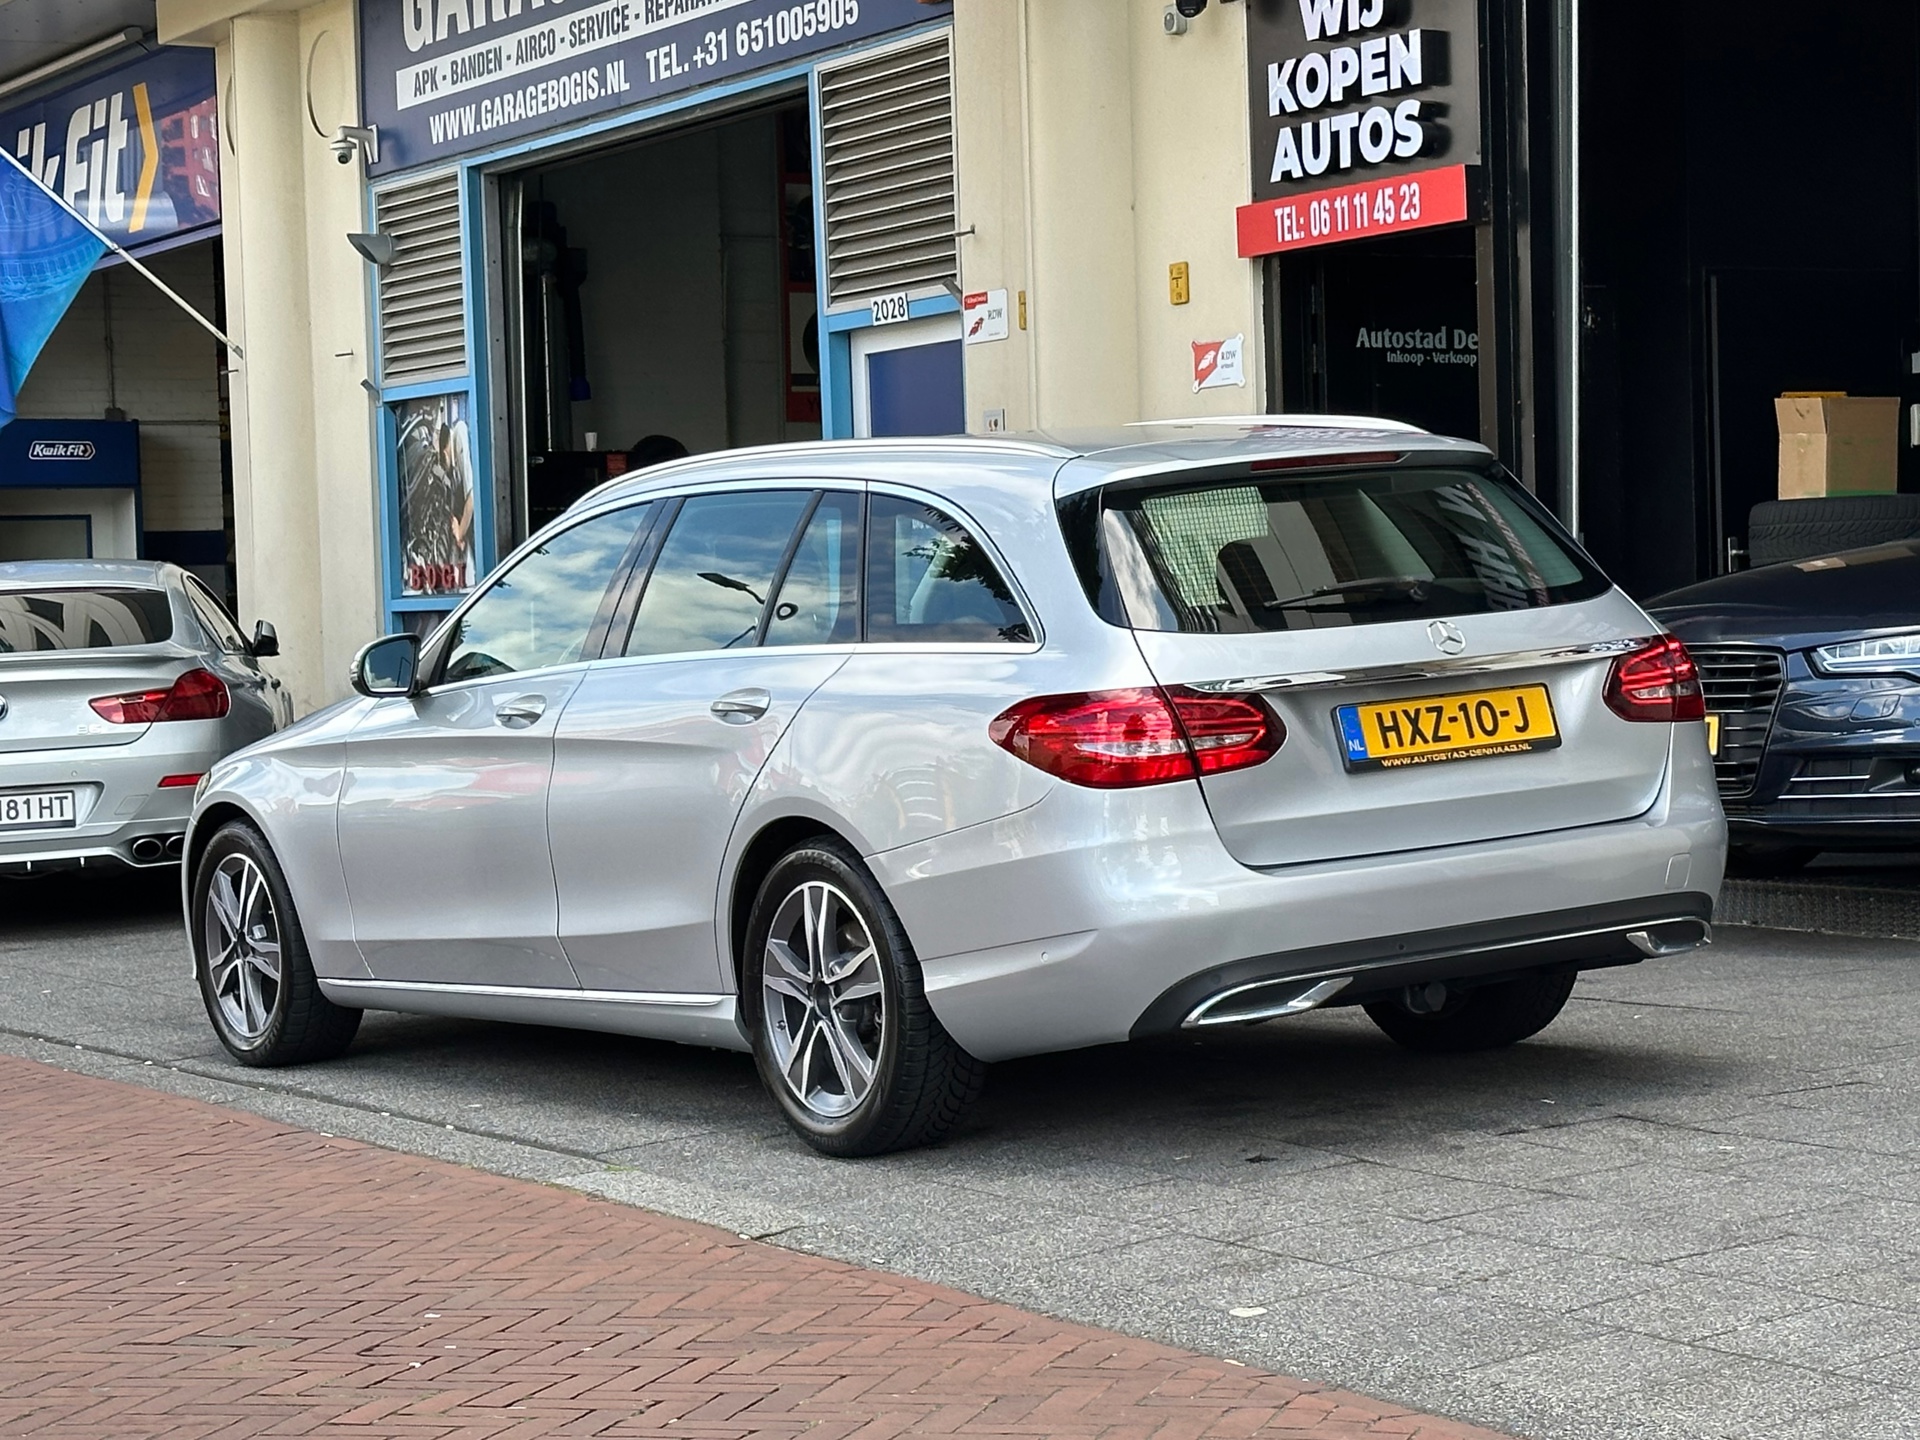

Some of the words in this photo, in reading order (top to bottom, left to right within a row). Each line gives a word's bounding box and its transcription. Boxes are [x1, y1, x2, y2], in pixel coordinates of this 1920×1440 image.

[414, 66, 439, 98] APK
[451, 46, 503, 86] BANDEN
[515, 28, 556, 66] AIRCO
[569, 4, 630, 49] SERVICE
[429, 59, 631, 145] WWW.GARAGEBOGIS.NL
[645, 43, 689, 83] TEL.
[692, 28, 728, 70] +31
[736, 0, 859, 56] 651005905
[1267, 28, 1422, 117] KOPEN
[1269, 99, 1424, 183] AUTOS
[1274, 204, 1305, 243] TEL:
[1309, 198, 1330, 237] 06
[1334, 195, 1349, 233] 11
[1353, 191, 1369, 229] 11
[1373, 186, 1395, 225] 45
[1399, 182, 1421, 221] 23
[872, 296, 906, 322] 2028
[1356, 326, 1447, 349] Autostad
[1387, 351, 1424, 366] Inkoop
[1432, 351, 1477, 367] Verkoop
[1349, 739, 1365, 751] NL
[1375, 696, 1530, 749] HXZ-10-J
[1381, 743, 1532, 767] WWW.AUTOSTAD-DENHAAG.NL
